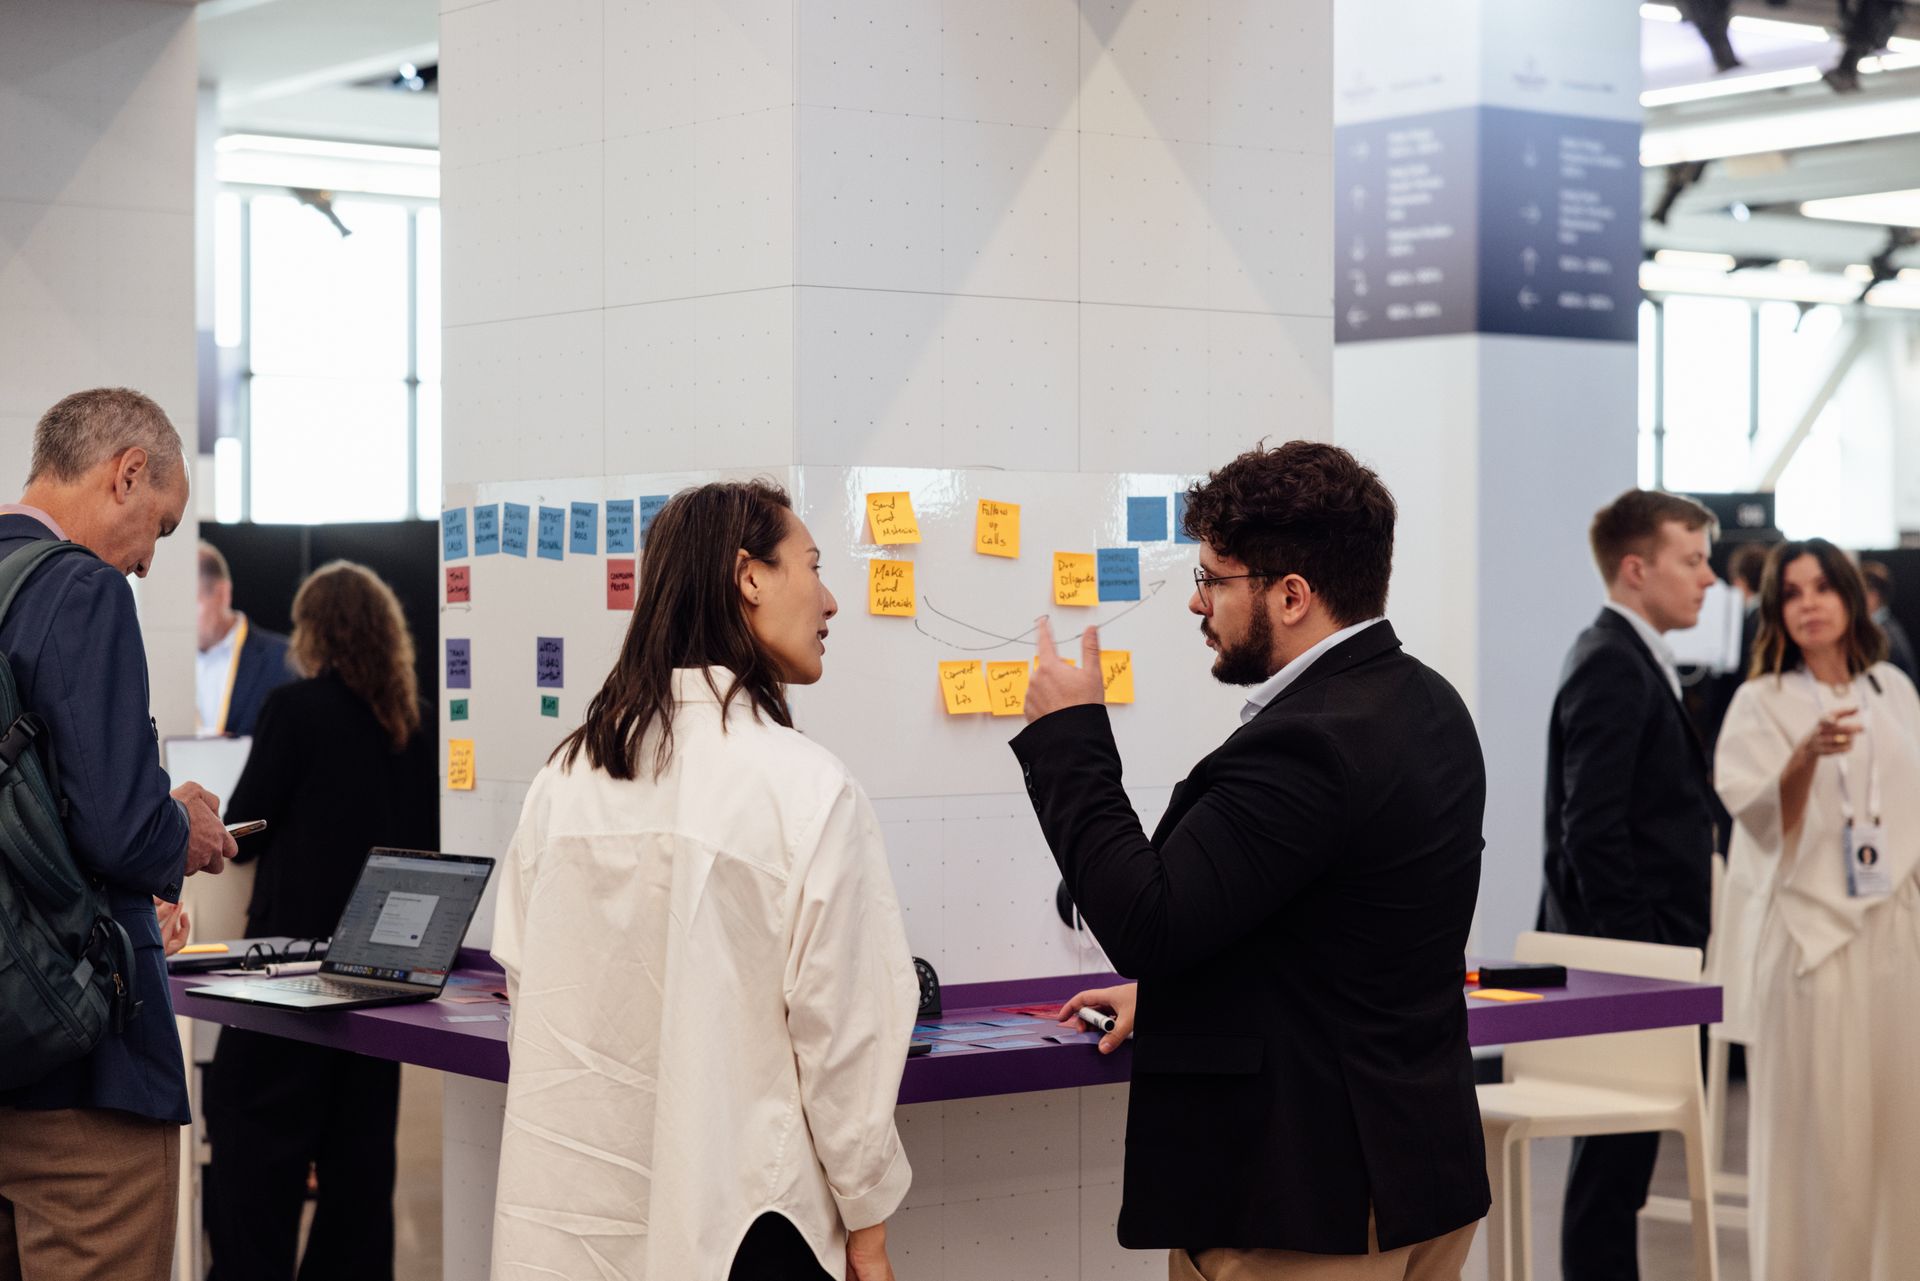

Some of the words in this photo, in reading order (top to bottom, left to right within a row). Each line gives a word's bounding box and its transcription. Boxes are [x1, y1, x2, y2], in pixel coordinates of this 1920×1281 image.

[872, 496, 895, 511] Send
[982, 503, 1008, 516] Follow
[874, 563, 904, 580] Make
